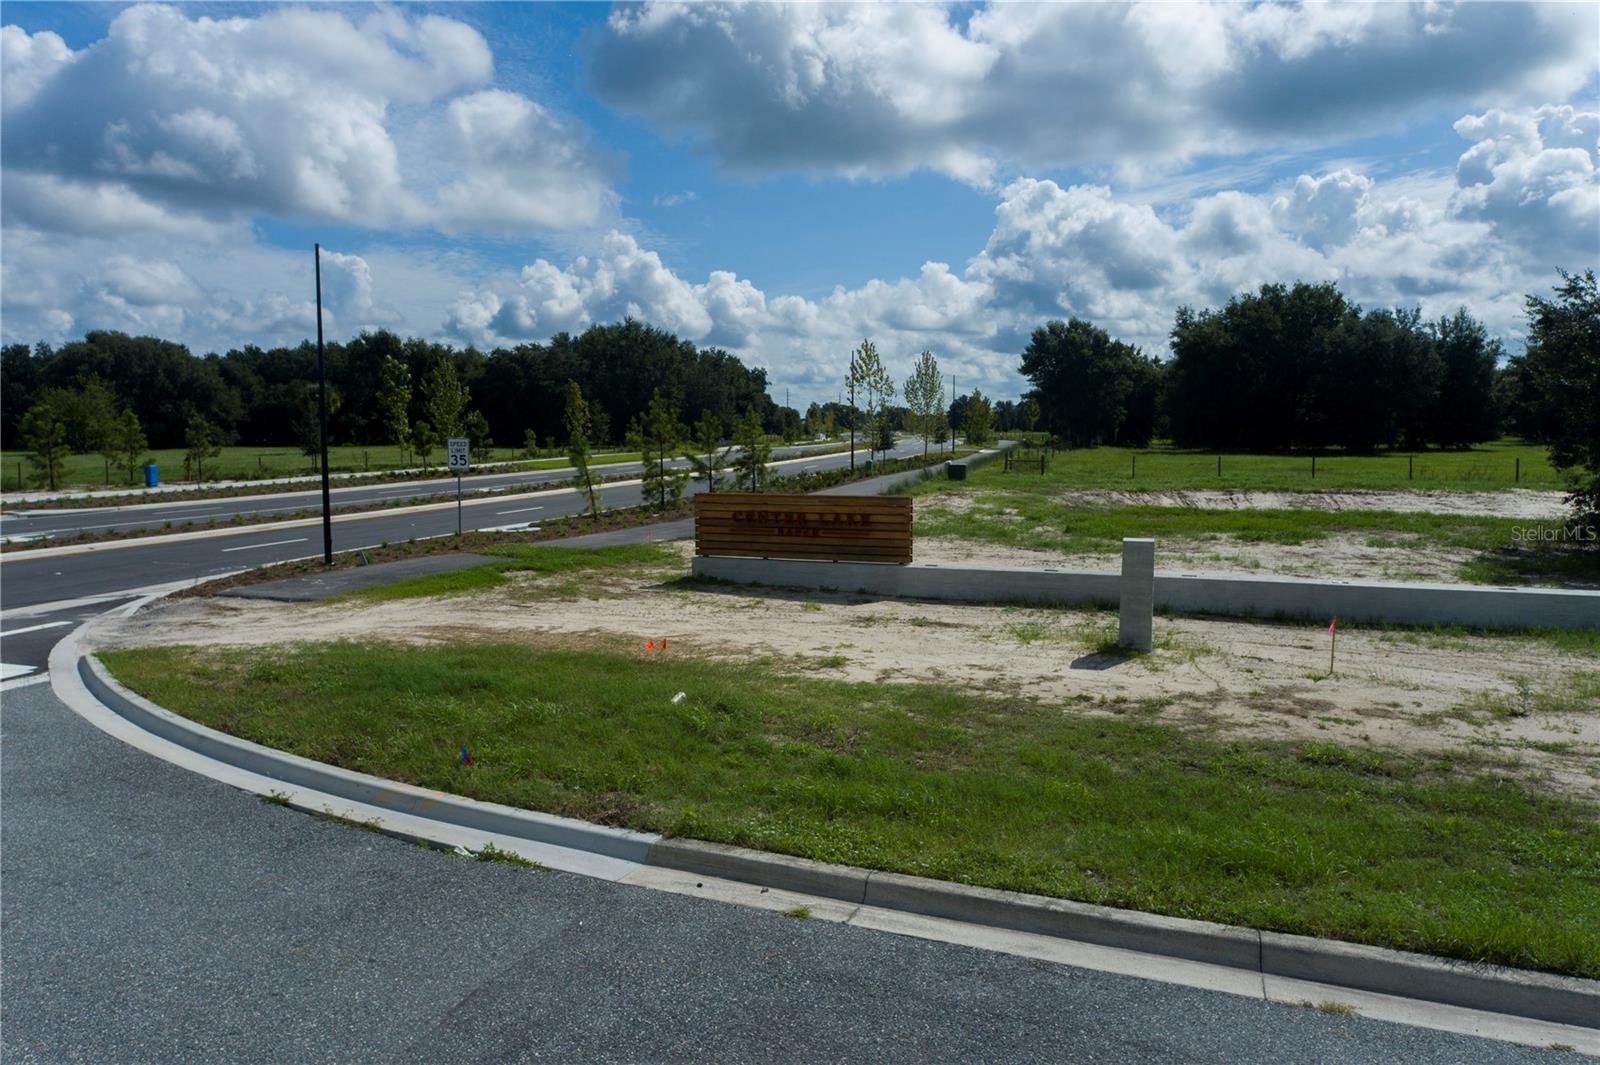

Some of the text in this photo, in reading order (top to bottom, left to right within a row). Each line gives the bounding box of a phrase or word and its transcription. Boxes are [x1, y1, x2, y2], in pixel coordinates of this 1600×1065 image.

[450, 454, 467, 466] 35
[732, 511, 872, 527] CENTER LAKE
